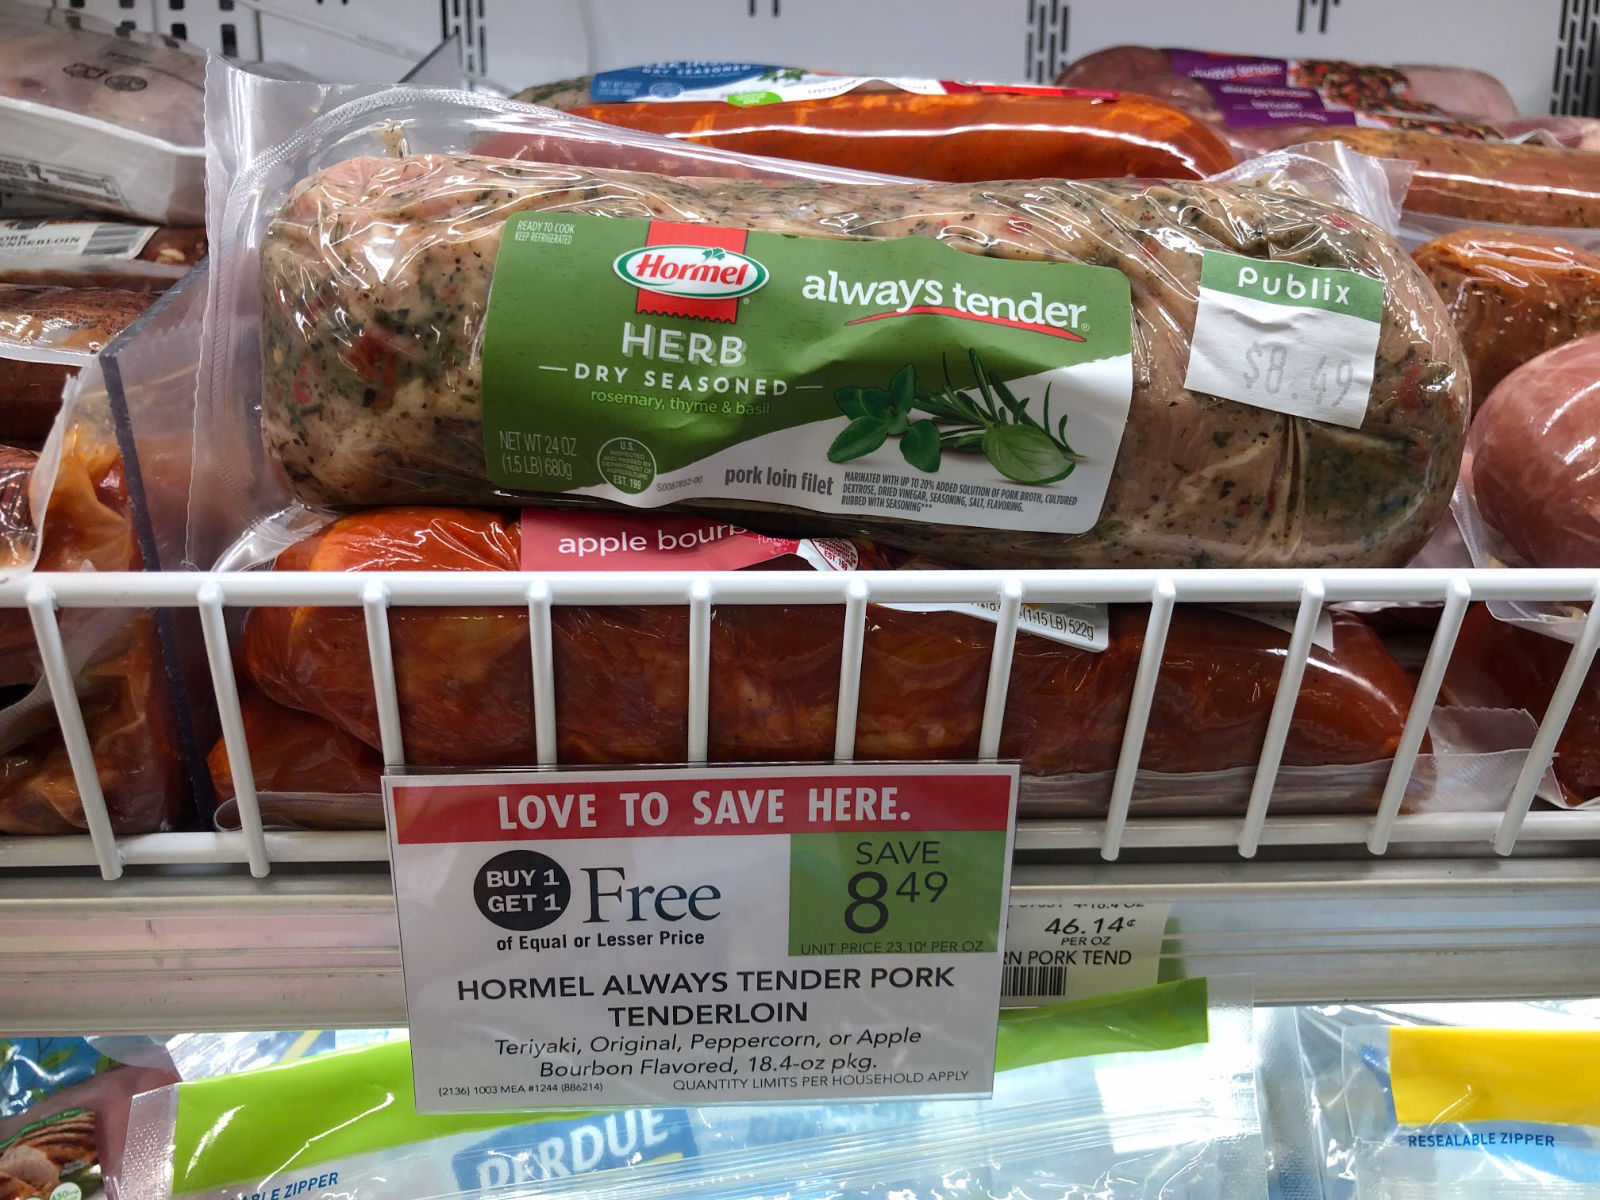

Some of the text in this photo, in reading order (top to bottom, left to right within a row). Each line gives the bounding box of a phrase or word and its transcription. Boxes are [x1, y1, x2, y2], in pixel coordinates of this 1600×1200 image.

[514, 231, 573, 245] KEEP REFRIGERATED
[517, 220, 576, 234] READY TO COOK
[636, 254, 749, 286] Hormel
[1238, 266, 1351, 305] Publix
[801, 270, 1087, 329] always tender
[622, 321, 748, 366] HERB
[574, 362, 789, 397] DRY SEASONED
[1242, 341, 1354, 408] $8.49
[591, 389, 771, 417] rosemary, thyme & basil
[499, 430, 578, 456] NET WT 24 OZ
[502, 453, 573, 480] (1.5 LB) 680g
[724, 466, 834, 496] pork loin filet
[844, 471, 1078, 506] MARINATED WITH UP TO 20% ADDED SOLUTION OF PORK BROTH, CULTURED
[841, 495, 866, 506] RUBBED
[868, 496, 885, 507] WITH
[843, 483, 1024, 512] DEXTROSE, DRIED VINEGAR, SEASONING, SALT, FLAVORING.
[558, 530, 647, 557] apple
[1050, 613, 1067, 633] LB)
[1068, 619, 1094, 641] 522g
[498, 787, 911, 830] LOVE TO SAVE HERE.
[856, 841, 940, 866] SAVE
[486, 868, 560, 888] BUY 1
[487, 894, 561, 913] GET 1
[580, 866, 721, 924] Free
[497, 930, 705, 953] of Equal or Lesser Price
[801, 943, 836, 955] UNIT
[841, 942, 881, 954] PRICE
[931, 941, 958, 953] PER
[962, 940, 984, 952] OZ
[1061, 936, 1111, 946] PER OZ
[1028, 950, 1077, 965] PORK
[1083, 950, 1132, 965] TEND
[457, 967, 955, 1000] HORMEL ALWAYS TENDER PORK
[608, 1001, 808, 1027] TENDERLOIN
[495, 1027, 921, 1058] Teriyaki, Original, Peppercorn, or Apple
[540, 1052, 877, 1078] Bourbon Flavored, 18.4-oz pkg.
[438, 1082, 603, 1097] (2136) 1003 MEA #1244 (886214)
[673, 1070, 970, 1091] QUANTITY LIMITS PER HOUSEHOLD APPLY
[1408, 1132, 1555, 1148] RESEALABLE ZIPPER
[284, 1172, 338, 1199] ZIPPER
